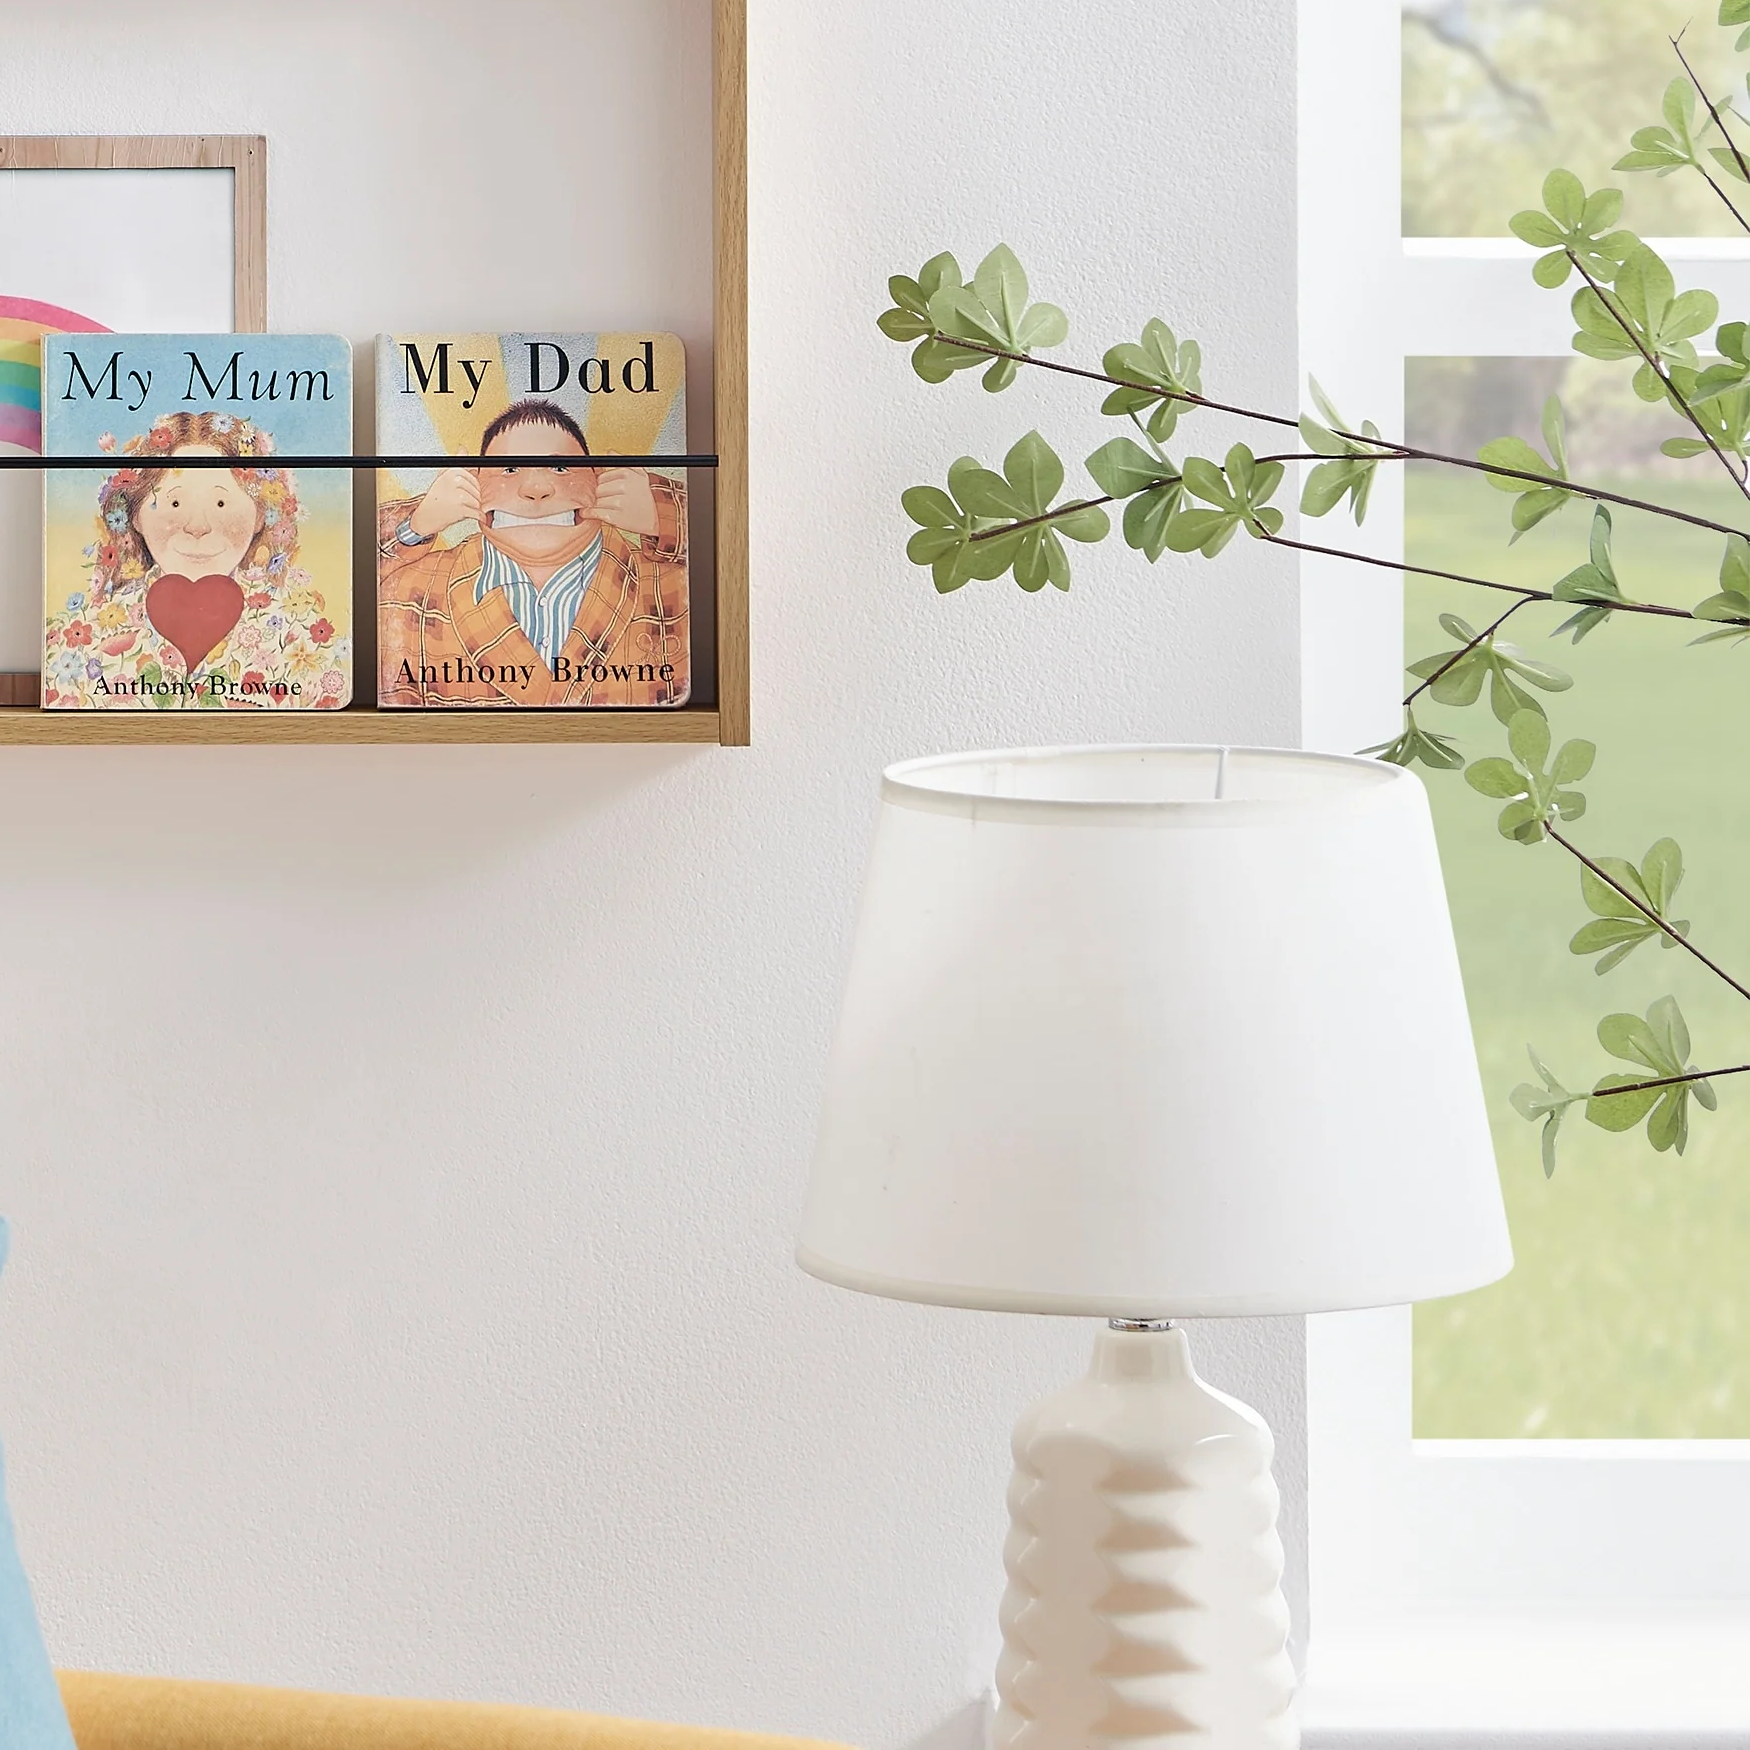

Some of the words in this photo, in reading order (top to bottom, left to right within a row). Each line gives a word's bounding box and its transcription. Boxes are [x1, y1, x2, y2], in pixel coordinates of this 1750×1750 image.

[61, 351, 154, 411] My
[183, 351, 335, 402] Mum
[400, 342, 493, 410] My
[524, 341, 661, 395] Dad
[92, 674, 207, 701] Anthony
[207, 674, 303, 697] Browne
[394, 657, 537, 691] Anthony
[552, 656, 677, 687] Browne
